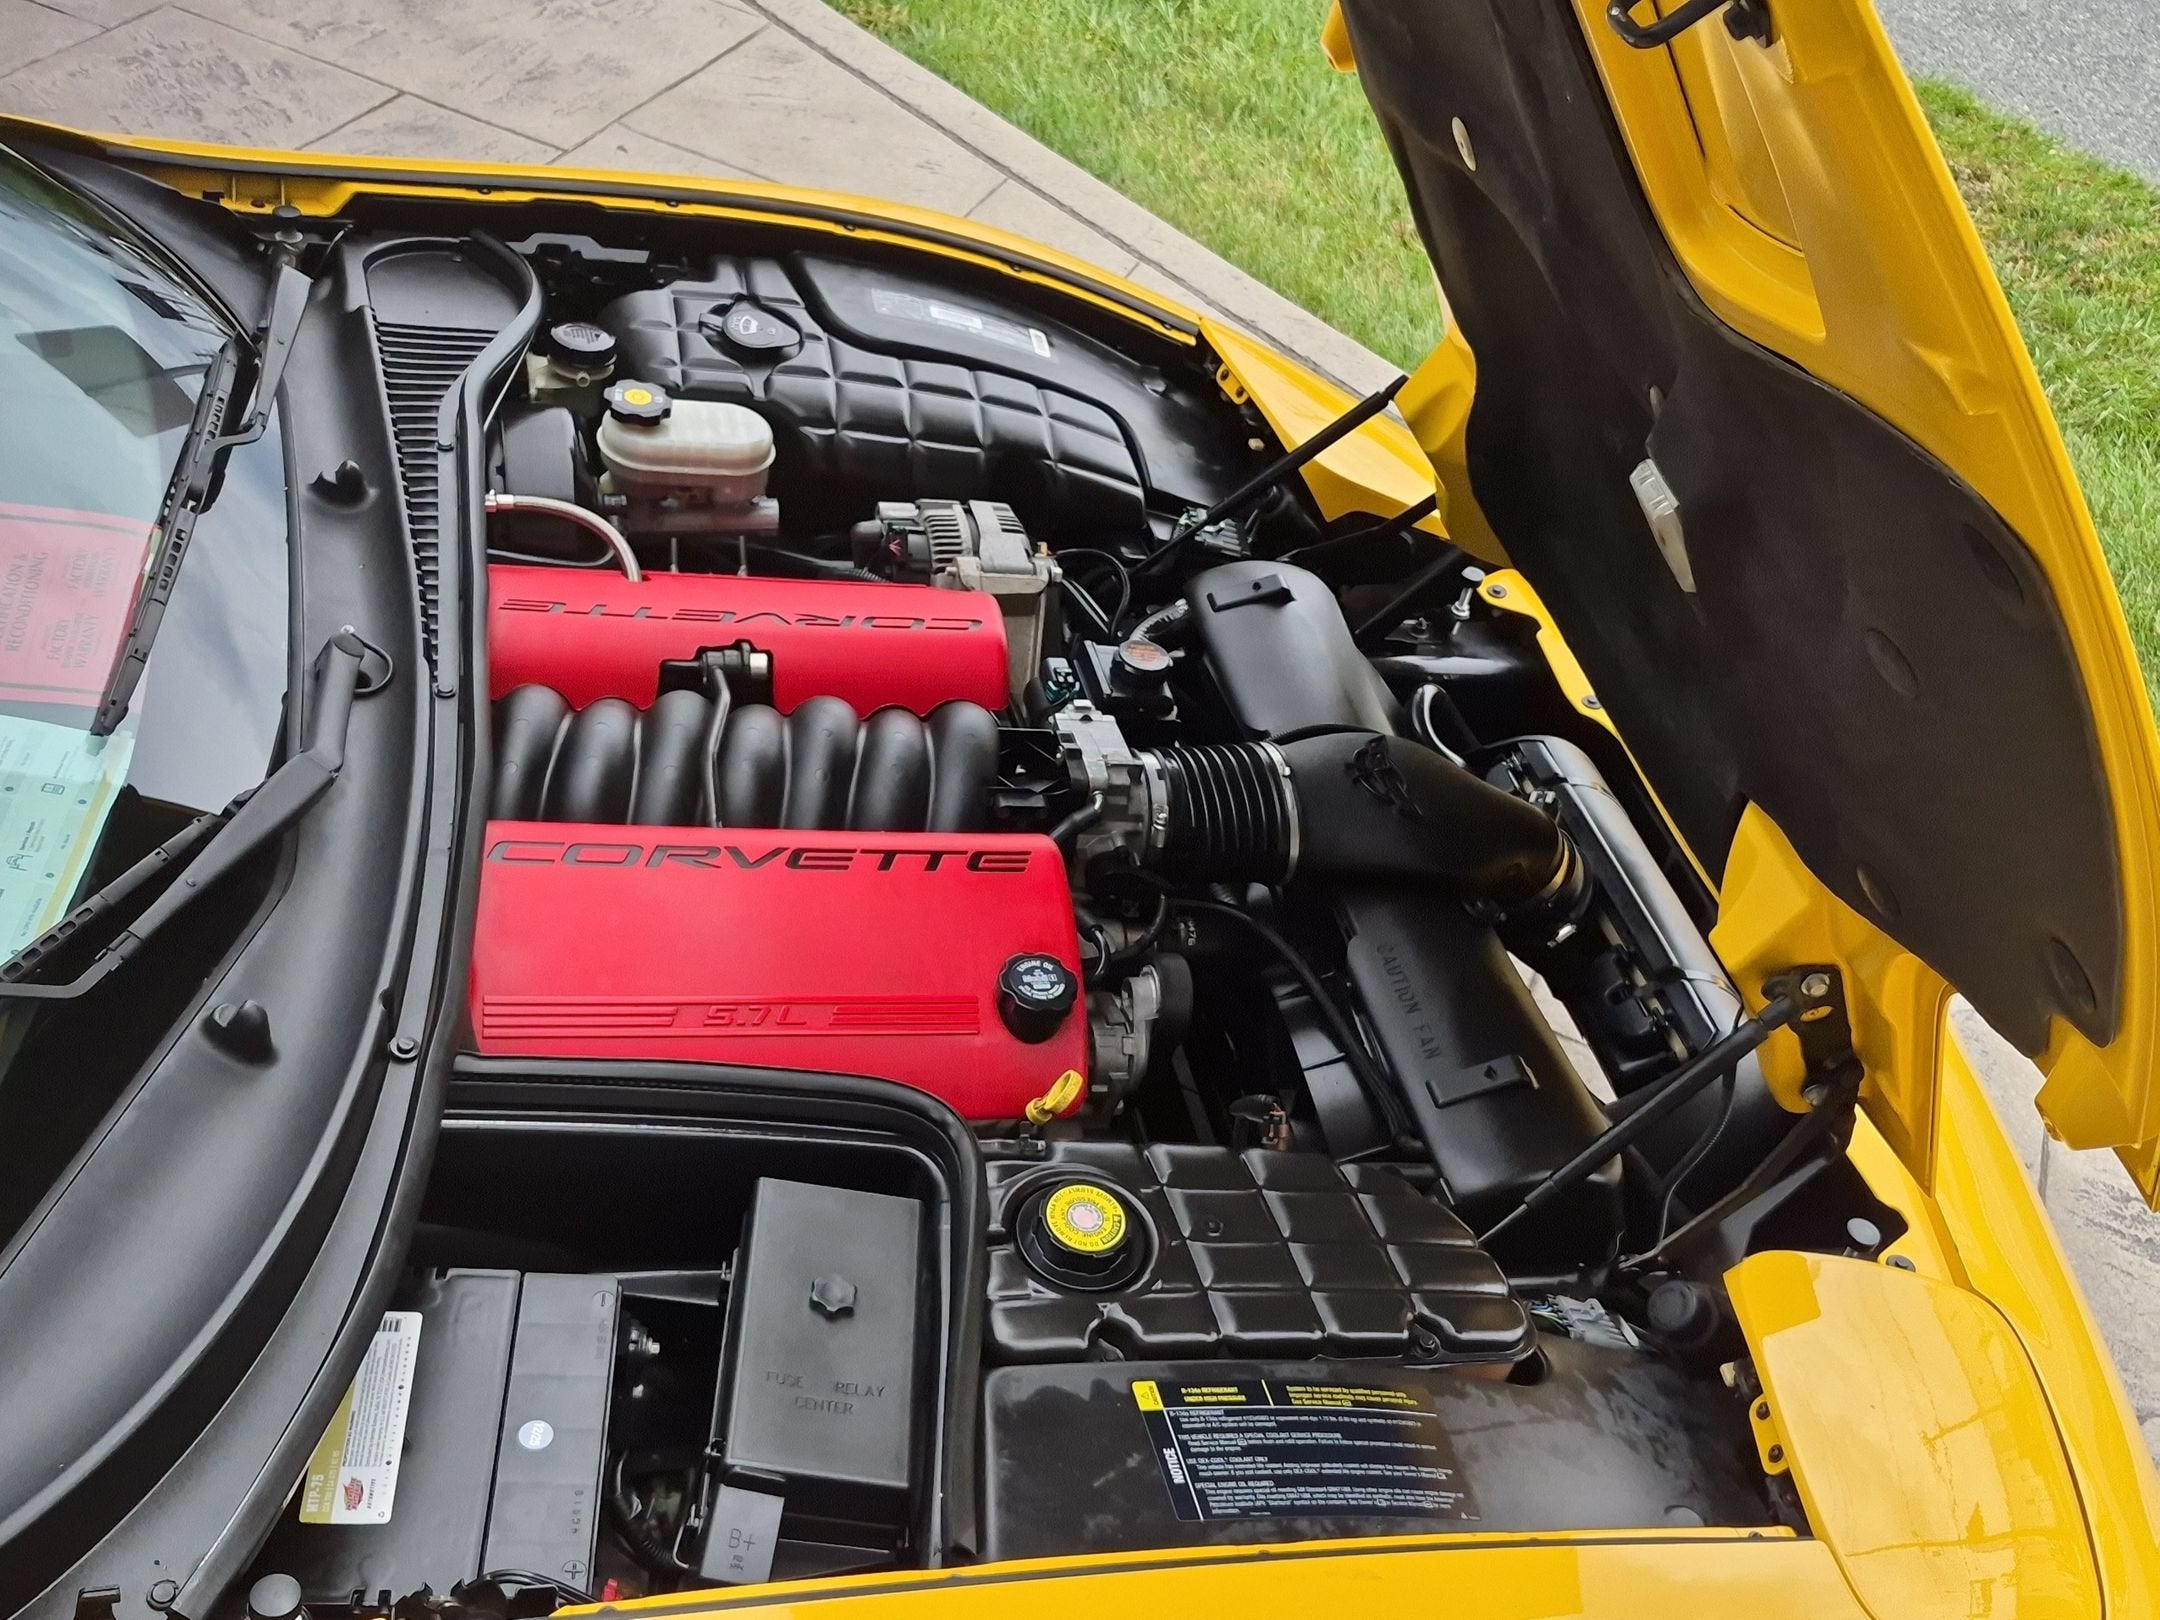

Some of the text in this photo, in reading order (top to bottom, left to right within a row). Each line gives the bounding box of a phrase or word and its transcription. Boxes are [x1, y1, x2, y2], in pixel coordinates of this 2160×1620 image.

[497, 598, 985, 631] CORVETTE
[487, 840, 1034, 873] CORVETTE
[1016, 960, 1041, 972] ENGINE
[1376, 944, 1441, 1061] CAUTION FAN
[703, 1005, 807, 1027] 5.7L
[834, 1380, 886, 1398] RELAY
[794, 1395, 854, 1416] CENTER
[1163, 1447, 1185, 1484] NOTICE
[728, 1528, 756, 1552] B+
